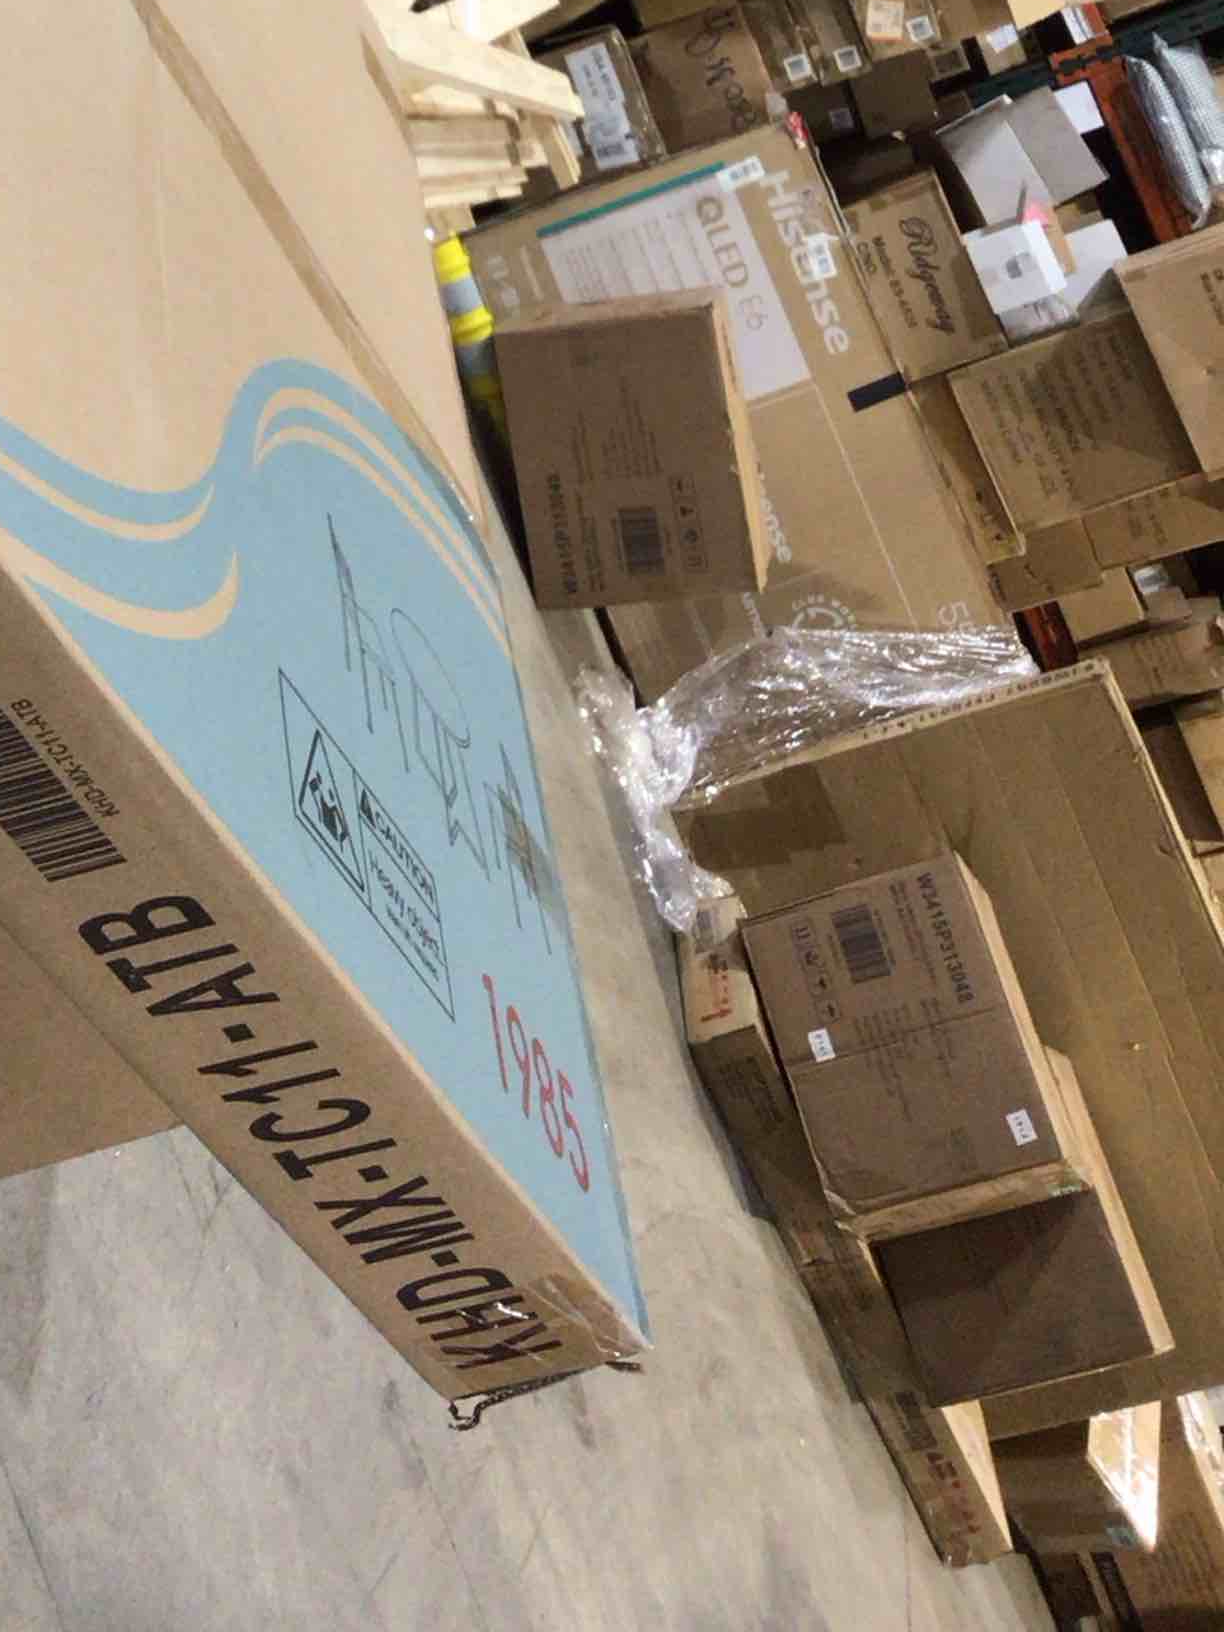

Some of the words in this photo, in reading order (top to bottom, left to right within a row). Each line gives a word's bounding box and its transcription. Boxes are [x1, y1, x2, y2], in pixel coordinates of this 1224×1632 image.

[695, 195, 751, 291] QLED
[898, 217, 955, 335] Ridgeway
[12, 698, 121, 819] KHD-MX-TC11-ATB
[374, 811, 435, 905] CAUTION
[78, 894, 563, 1370] KHD-MX-TC11-ATB
[481, 973, 592, 1193] 1985
